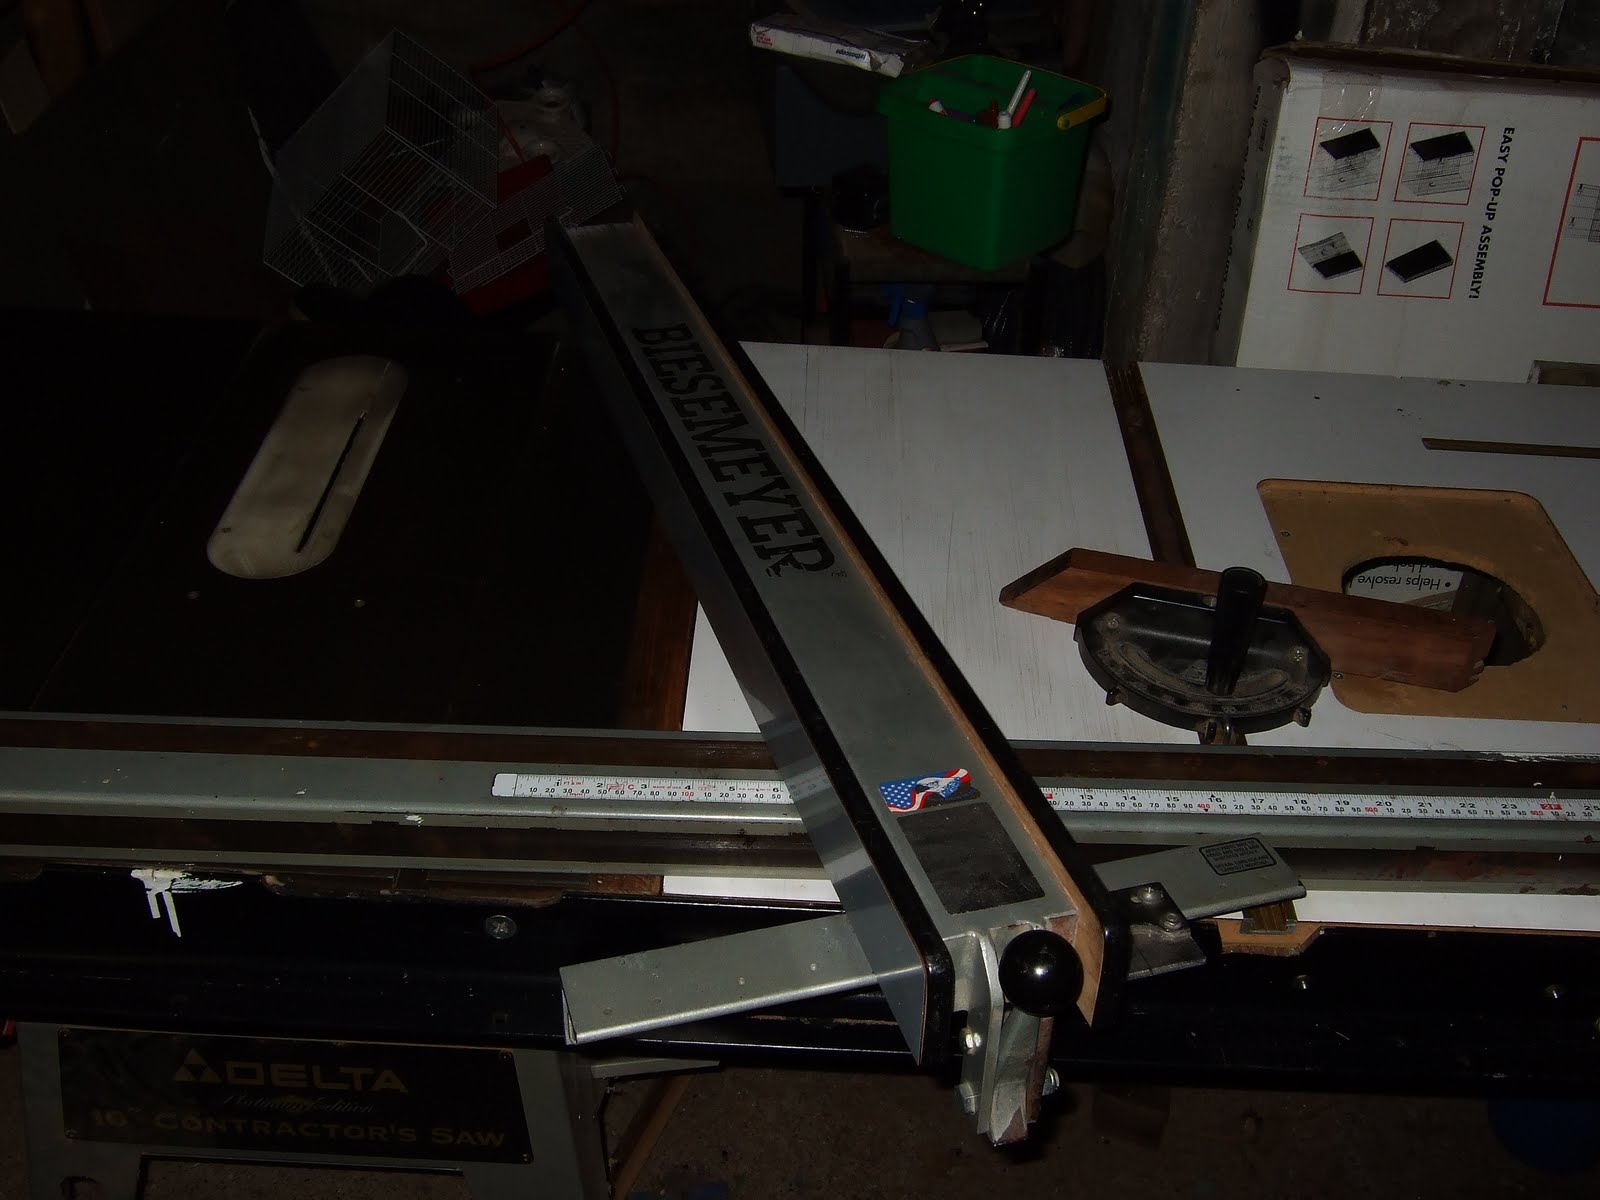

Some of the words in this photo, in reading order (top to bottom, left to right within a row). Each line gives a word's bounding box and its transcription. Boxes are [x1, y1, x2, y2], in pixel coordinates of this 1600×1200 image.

[1497, 127, 1515, 163] EASY
[1485, 167, 1504, 221] POP-UP
[1468, 225, 1490, 299] ASSEMBLY!
[631, 323, 835, 577] BIESEMEYER
[1357, 574, 1402, 589] resolve
[1405, 574, 1441, 591] Helps
[224, 1059, 409, 1095] DELTA
[152, 1110, 416, 1144] CONTRACTOR'S
[432, 1127, 505, 1148] SAW
